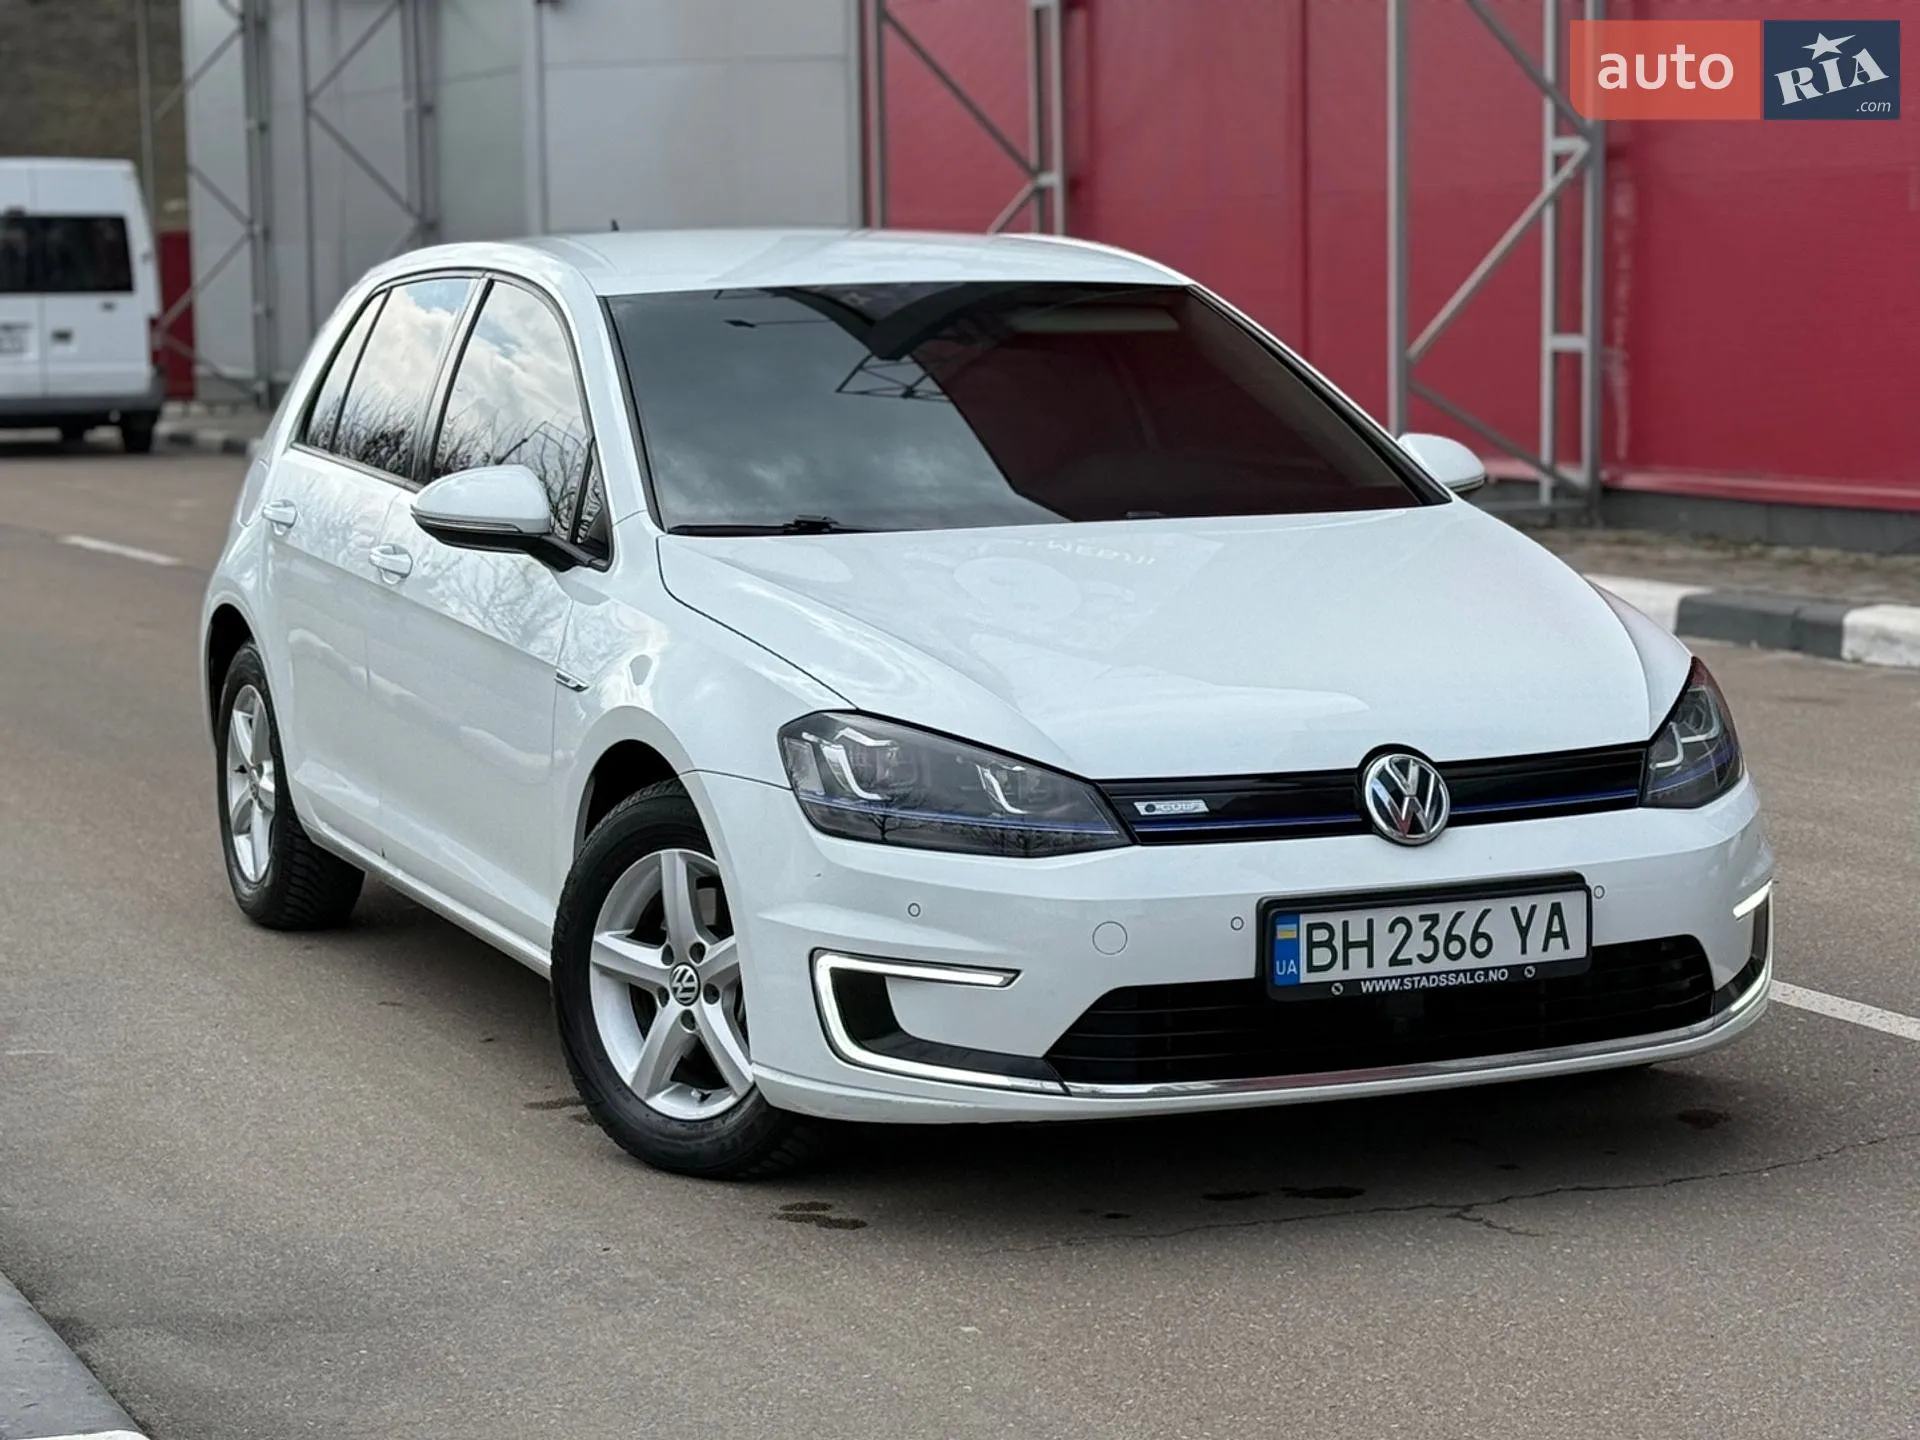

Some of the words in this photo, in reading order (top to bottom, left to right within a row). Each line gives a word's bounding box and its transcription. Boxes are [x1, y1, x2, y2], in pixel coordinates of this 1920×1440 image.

[1305, 918, 1375, 974] BH
[1387, 908, 1494, 968] 2366
[1510, 901, 1571, 956] YA
[1275, 959, 1298, 976] UA
[1360, 968, 1509, 994] WWW.STADSSALG.NO
